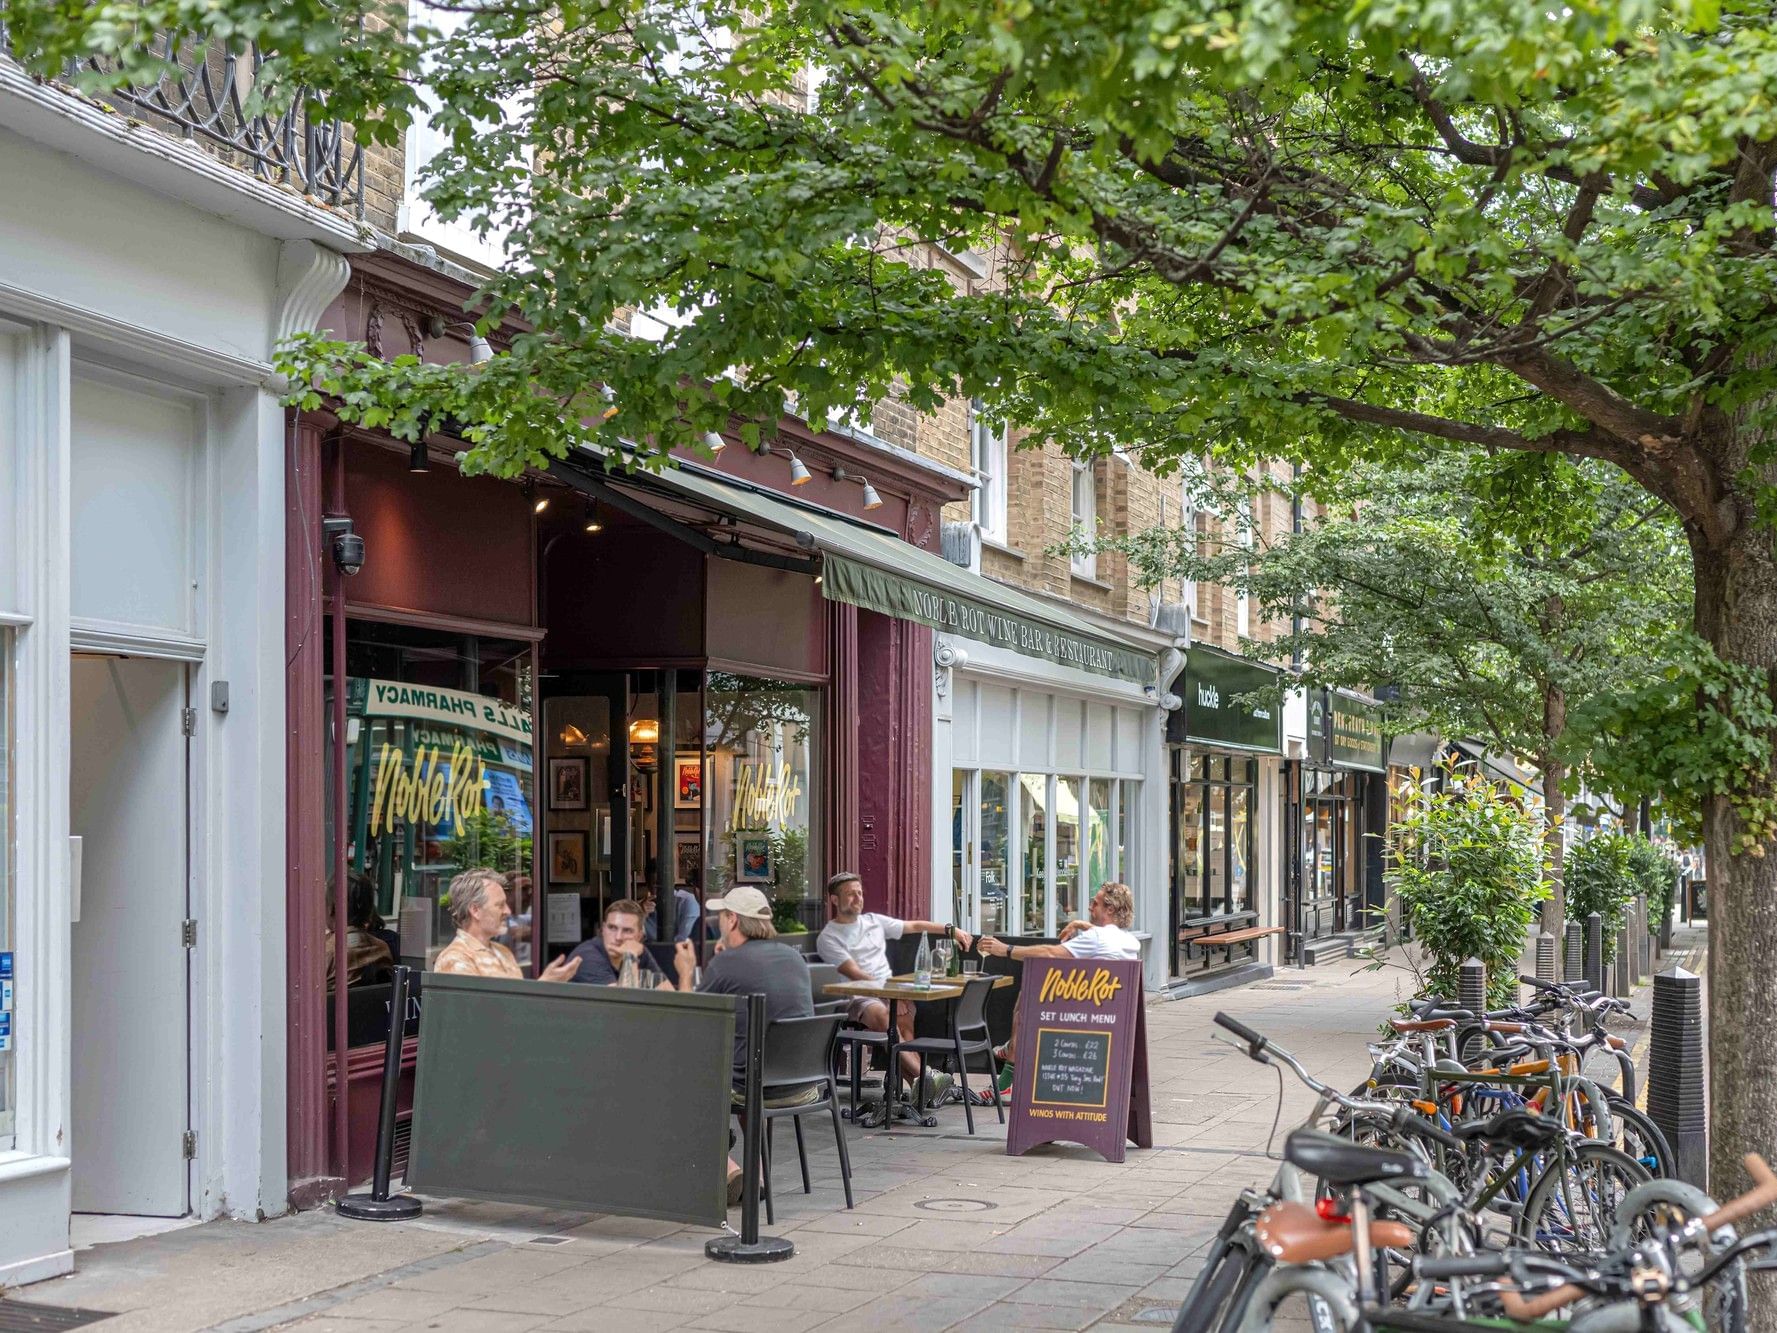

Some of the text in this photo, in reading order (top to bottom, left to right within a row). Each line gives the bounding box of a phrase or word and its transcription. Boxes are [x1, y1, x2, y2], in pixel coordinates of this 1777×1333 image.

[913, 590, 1113, 672] NOBLE ROT WINE BAR & RESTAURANT
[1198, 682, 1219, 709] huckle
[985, 870, 996, 883] Folk
[1040, 1011, 1116, 1024] SET LUNCH MENU
[1029, 1108, 1107, 1122] WINOS WITH ATTITUDE
